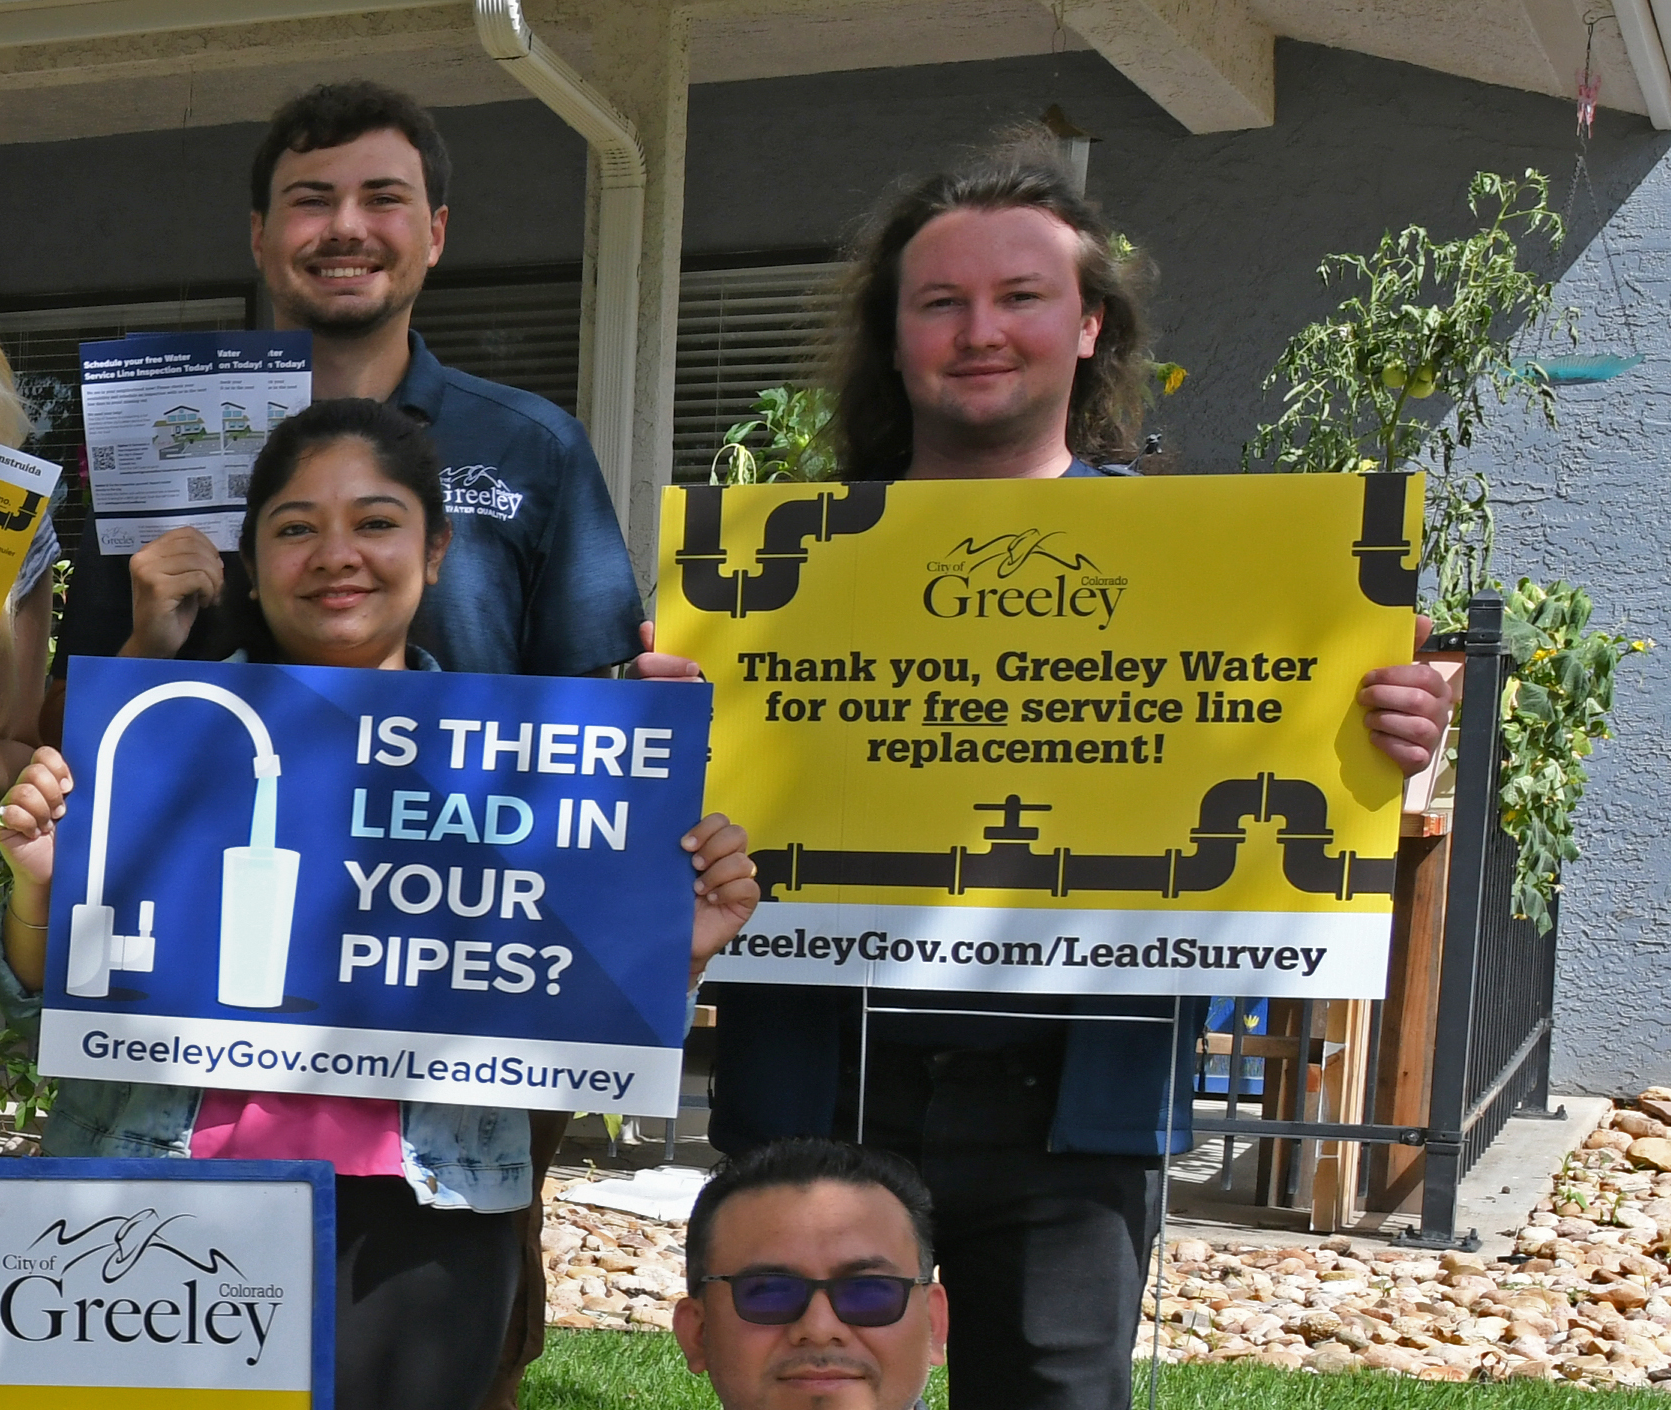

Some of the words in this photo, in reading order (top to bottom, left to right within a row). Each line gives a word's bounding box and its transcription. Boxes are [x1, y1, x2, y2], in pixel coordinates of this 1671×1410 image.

[83, 358, 122, 369] Schedule
[123, 358, 143, 367] your
[163, 353, 190, 362] Water
[84, 370, 115, 380] Service
[116, 369, 135, 377] Line
[136, 365, 182, 376] Inspection
[183, 362, 212, 372] Today!
[445, 506, 474, 514] WATER
[477, 507, 509, 521] QUALITY
[923, 574, 1127, 630] Greeley
[737, 651, 875, 681] Thank
[889, 658, 980, 687] you,
[996, 650, 1166, 687] Greeley
[1179, 651, 1316, 681] Water
[765, 690, 826, 721] for
[838, 698, 910, 721] our
[921, 690, 1008, 722] free
[1021, 690, 1183, 723] service
[1195, 691, 1282, 723] line
[357, 715, 417, 765] IS
[439, 719, 671, 777] THERE
[867, 731, 1163, 767] replacement!
[351, 788, 533, 844] LEAD
[556, 798, 627, 849] IN
[344, 860, 544, 919] YOUR
[339, 934, 572, 995] PIPES?
[715, 928, 1327, 976] reeleyGov.com/LeadSurvey
[82, 1030, 634, 1099] GreeleyGov.com/LeadSurvey
[2, 1254, 37, 1274] City
[39, 1255, 57, 1271] of
[219, 1283, 284, 1298] Colorado
[0, 1275, 283, 1366] Greeley
